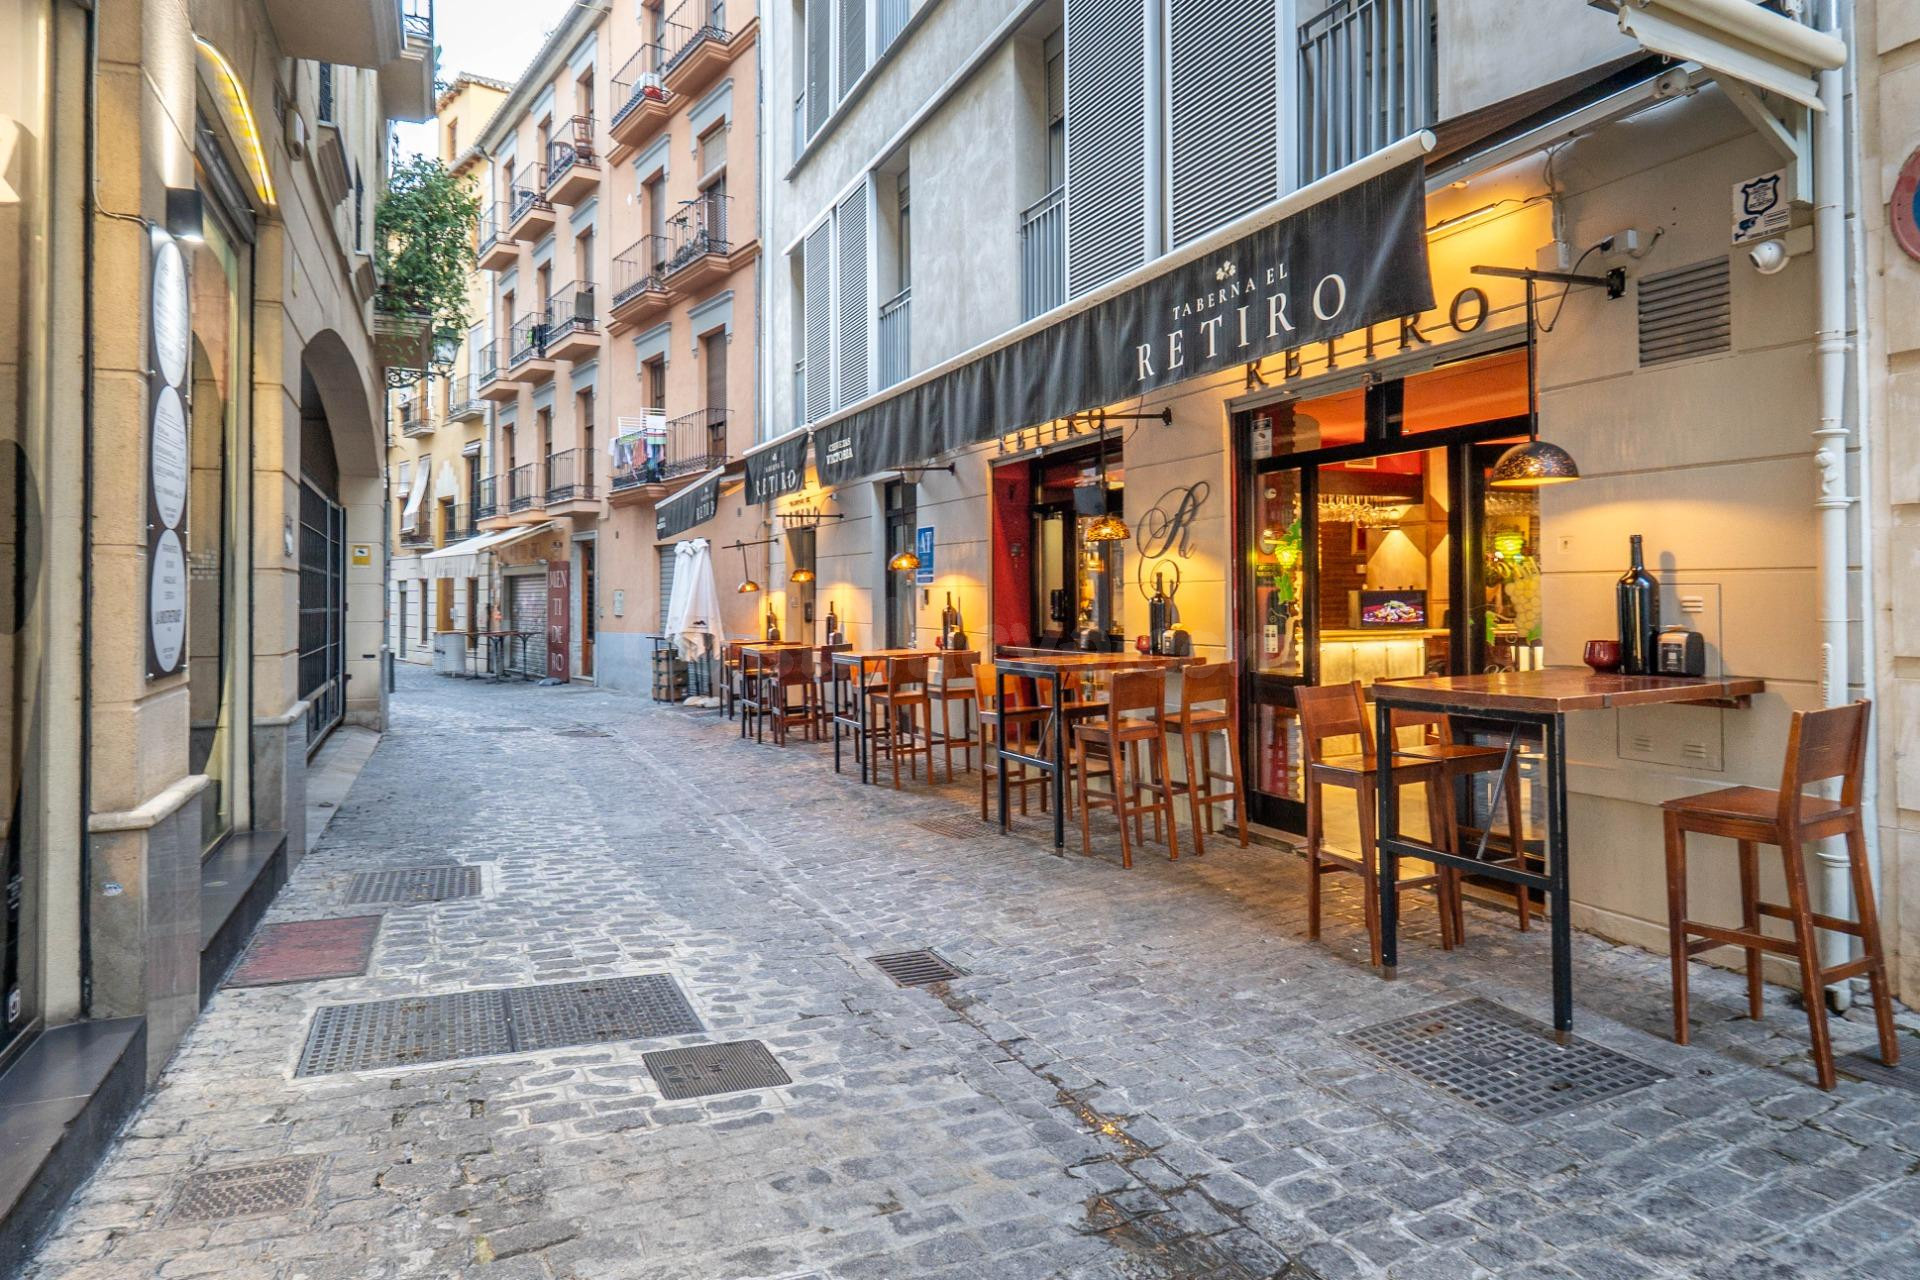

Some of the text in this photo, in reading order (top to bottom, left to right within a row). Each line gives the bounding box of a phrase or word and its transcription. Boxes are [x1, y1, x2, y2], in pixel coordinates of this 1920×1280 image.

[1135, 273, 1347, 382] RETIRO
[1172, 263, 1288, 321] TABERNA EL
